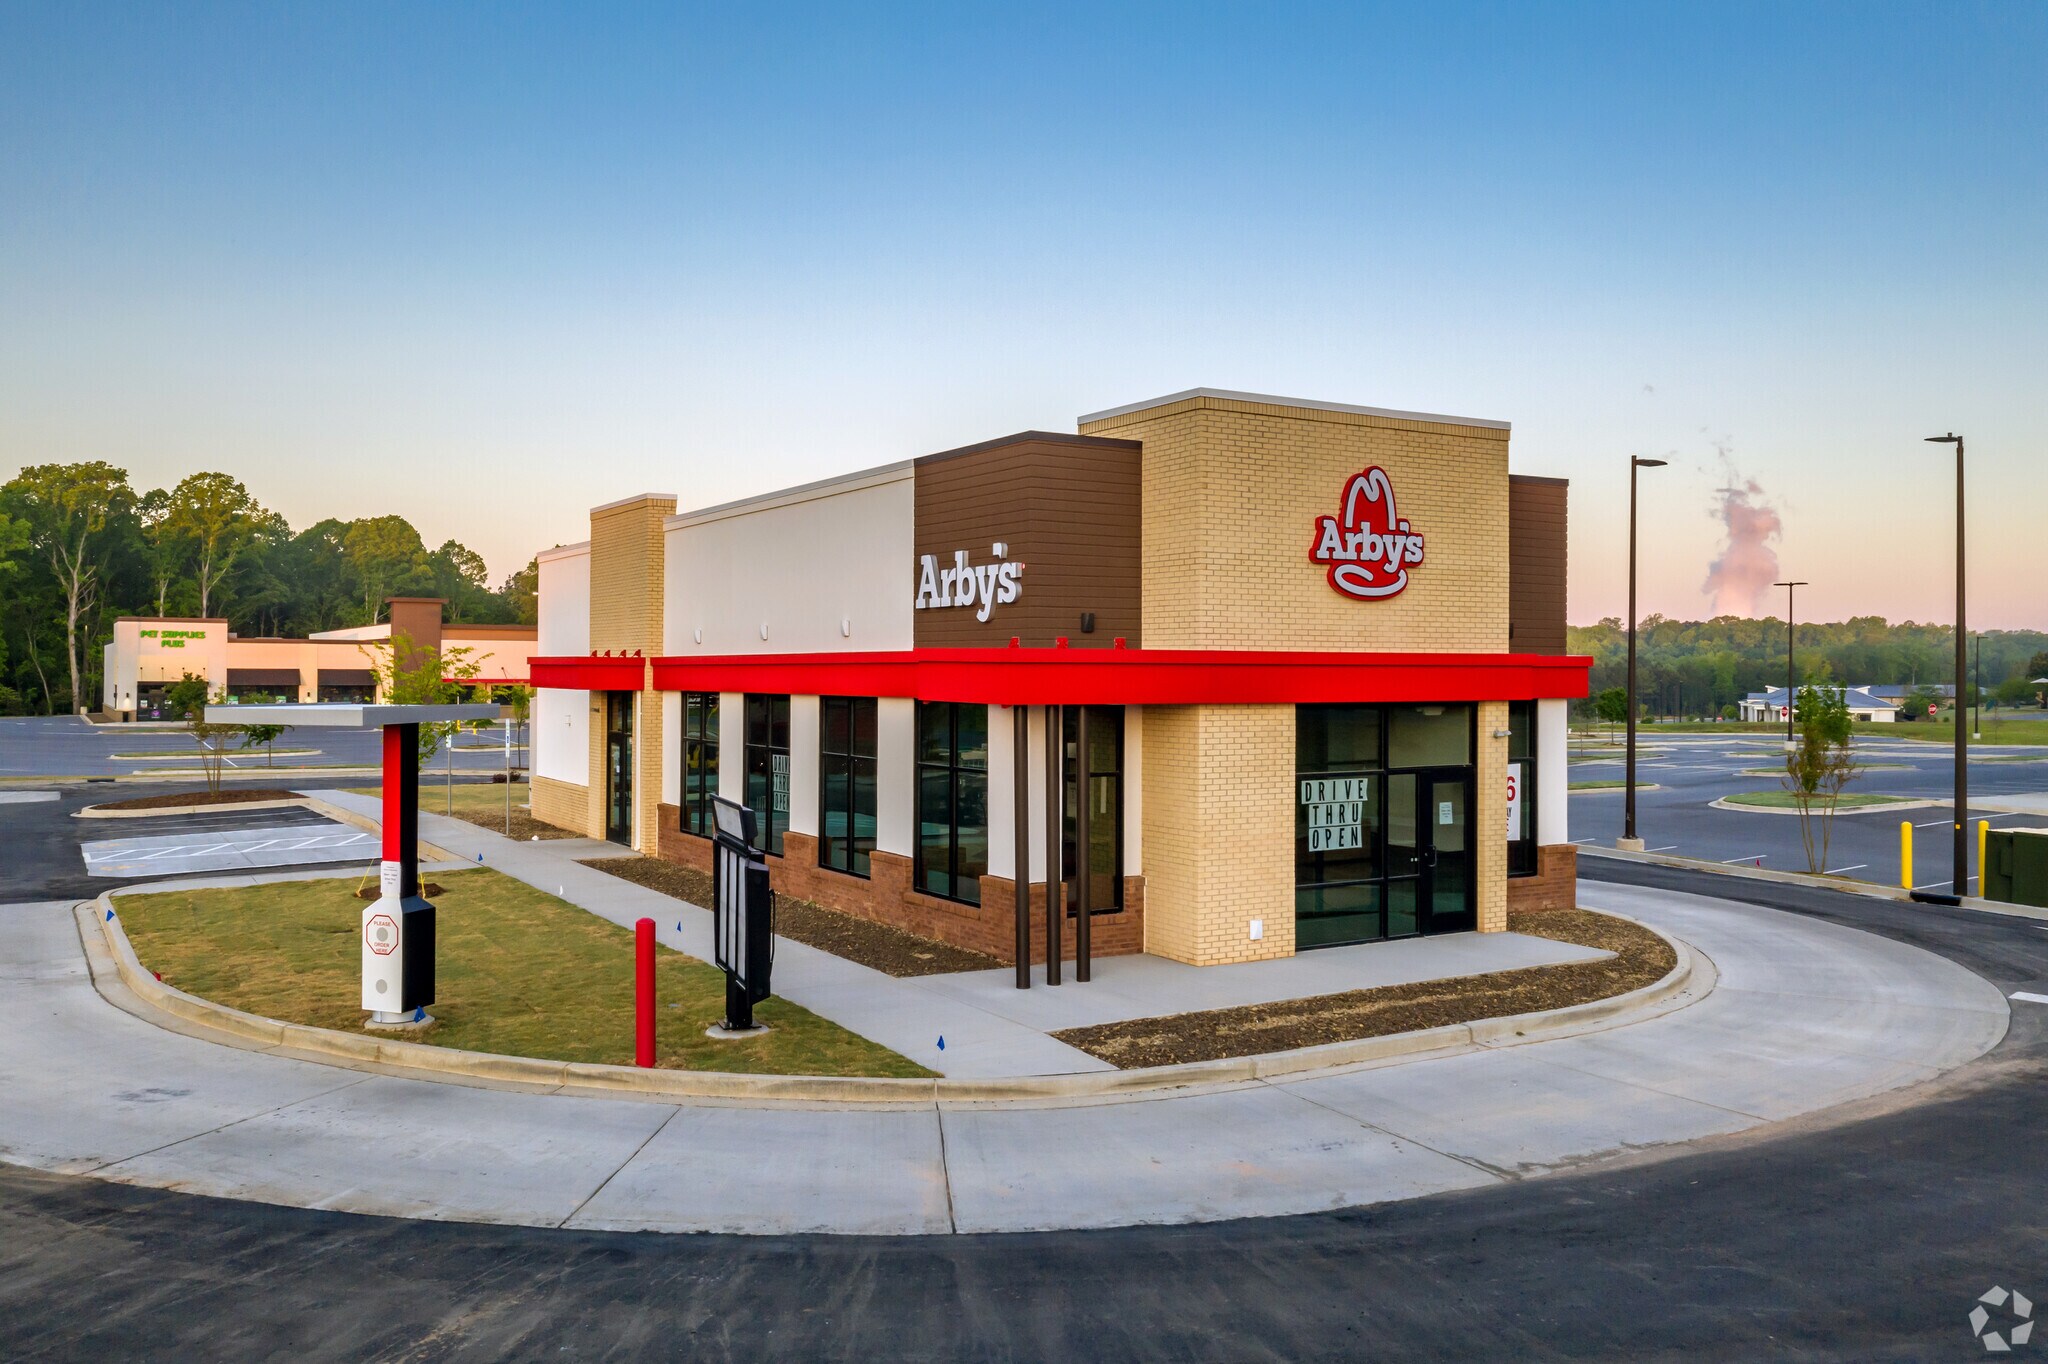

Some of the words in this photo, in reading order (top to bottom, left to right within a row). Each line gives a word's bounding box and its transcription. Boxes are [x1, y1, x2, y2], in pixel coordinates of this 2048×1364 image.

[1316, 519, 1424, 573] Arby's
[916, 542, 1023, 622] Arby's
[140, 630, 158, 638] PET
[161, 630, 206, 639] SUPPLIES
[161, 639, 186, 648] PLUS
[774, 755, 790, 772] DRIV
[1305, 780, 1364, 802] DRIVE
[1312, 803, 1359, 826] THRU
[1312, 827, 1358, 849] OPEN
